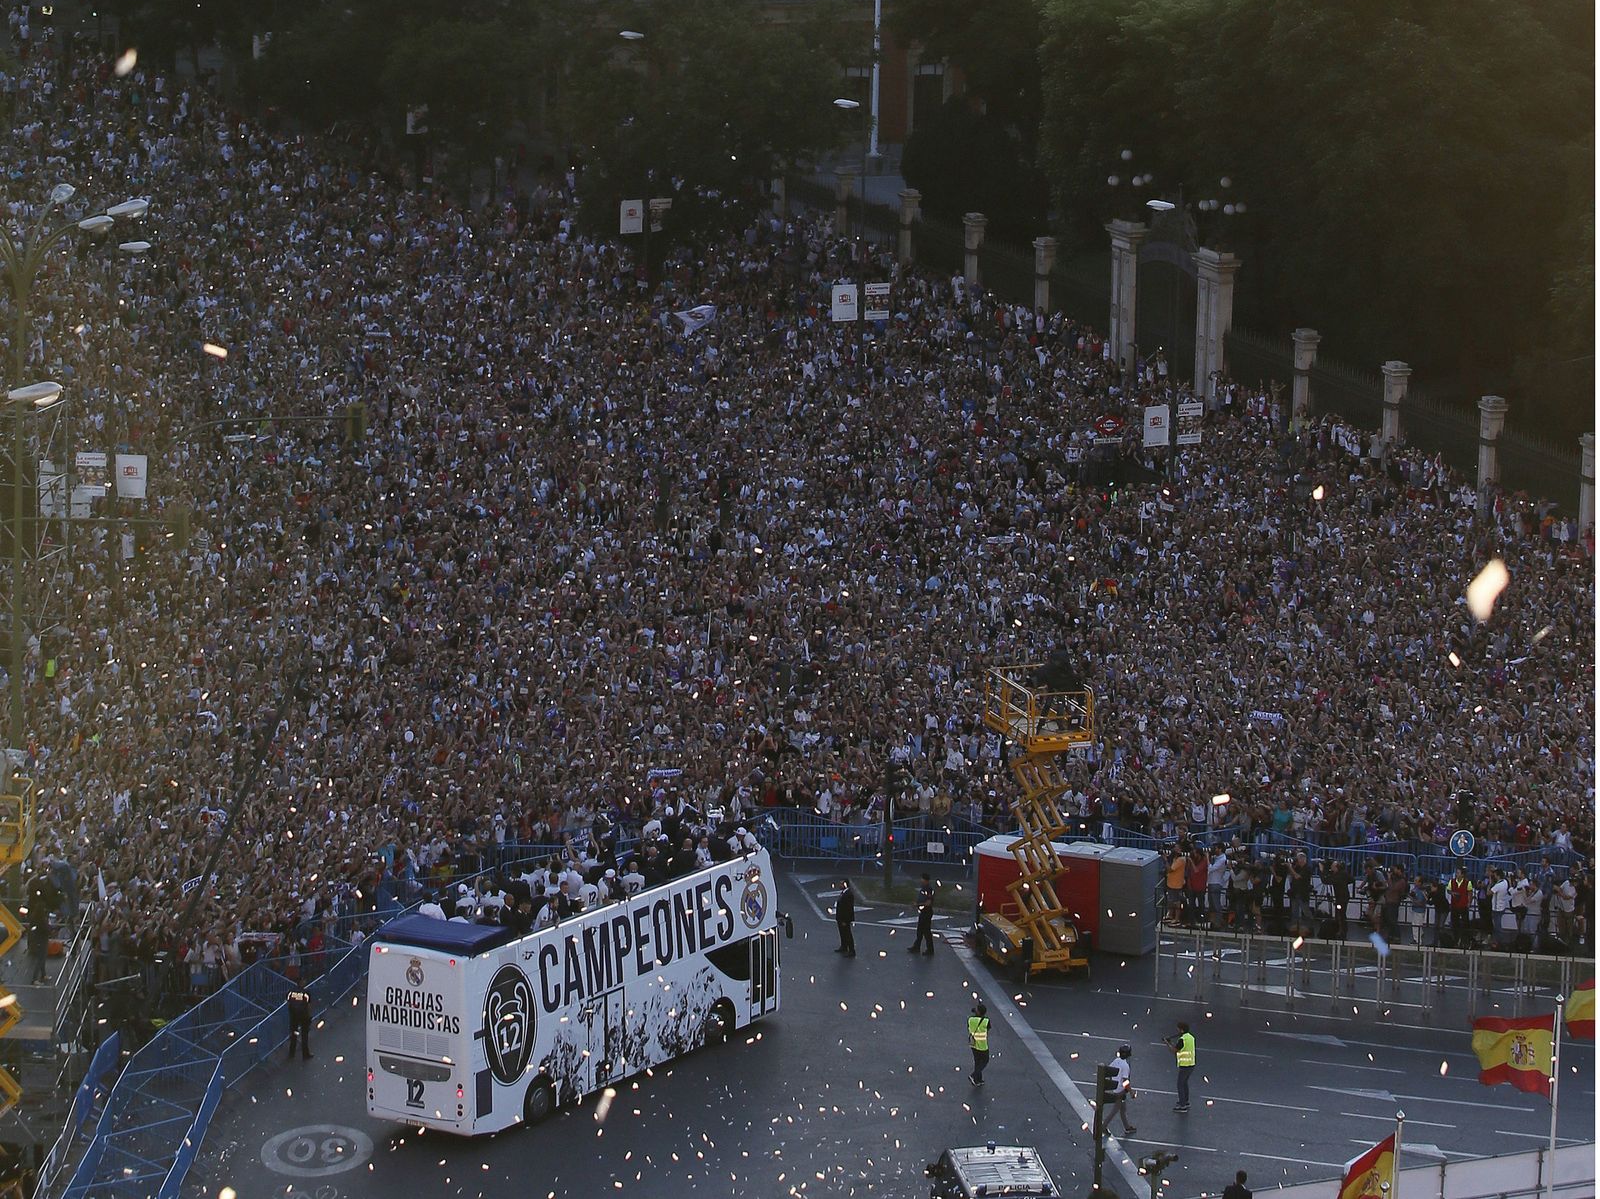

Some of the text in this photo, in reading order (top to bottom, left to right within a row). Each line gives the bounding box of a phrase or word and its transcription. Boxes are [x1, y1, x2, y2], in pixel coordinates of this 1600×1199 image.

[538, 874, 735, 1014] CAMPEONES
[386, 986, 443, 1012] GRACIAS
[369, 1003, 460, 1035] MADRIDISTAS
[500, 1021, 522, 1055] 12
[405, 1078, 426, 1108] 12
